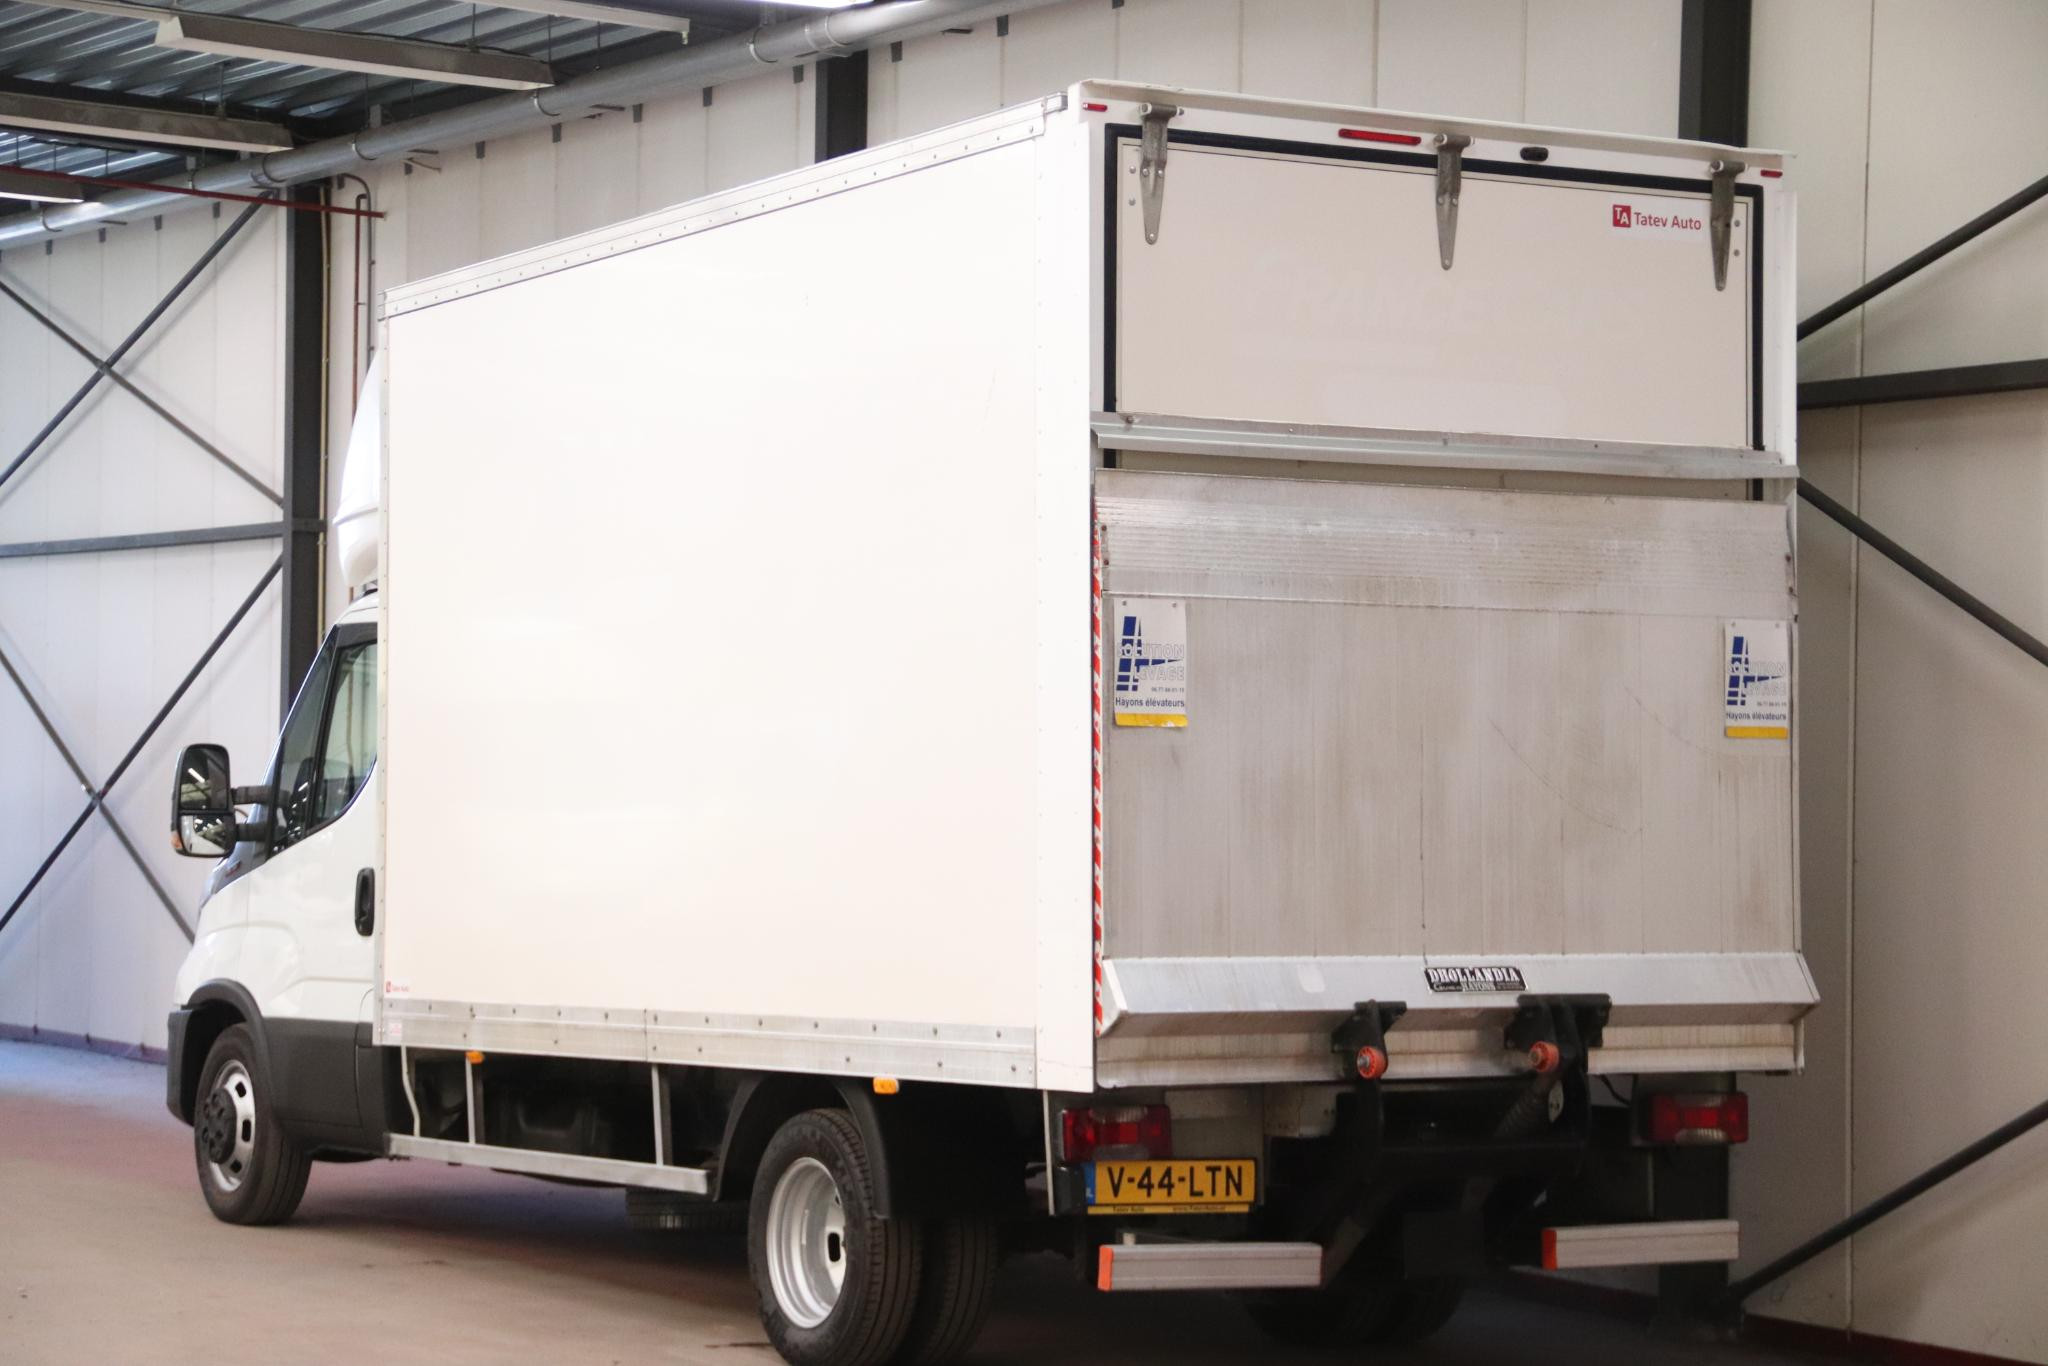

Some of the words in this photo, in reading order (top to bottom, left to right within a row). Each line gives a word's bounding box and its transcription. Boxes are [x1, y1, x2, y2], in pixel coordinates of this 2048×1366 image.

[1634, 212, 1668, 228] Tatev
[1671, 215, 1702, 231] Auto
[1115, 697, 1144, 708] Hayons
[1427, 967, 1520, 983] DHOLLANDIA
[1107, 1165, 1243, 1198] V-44-LTN
